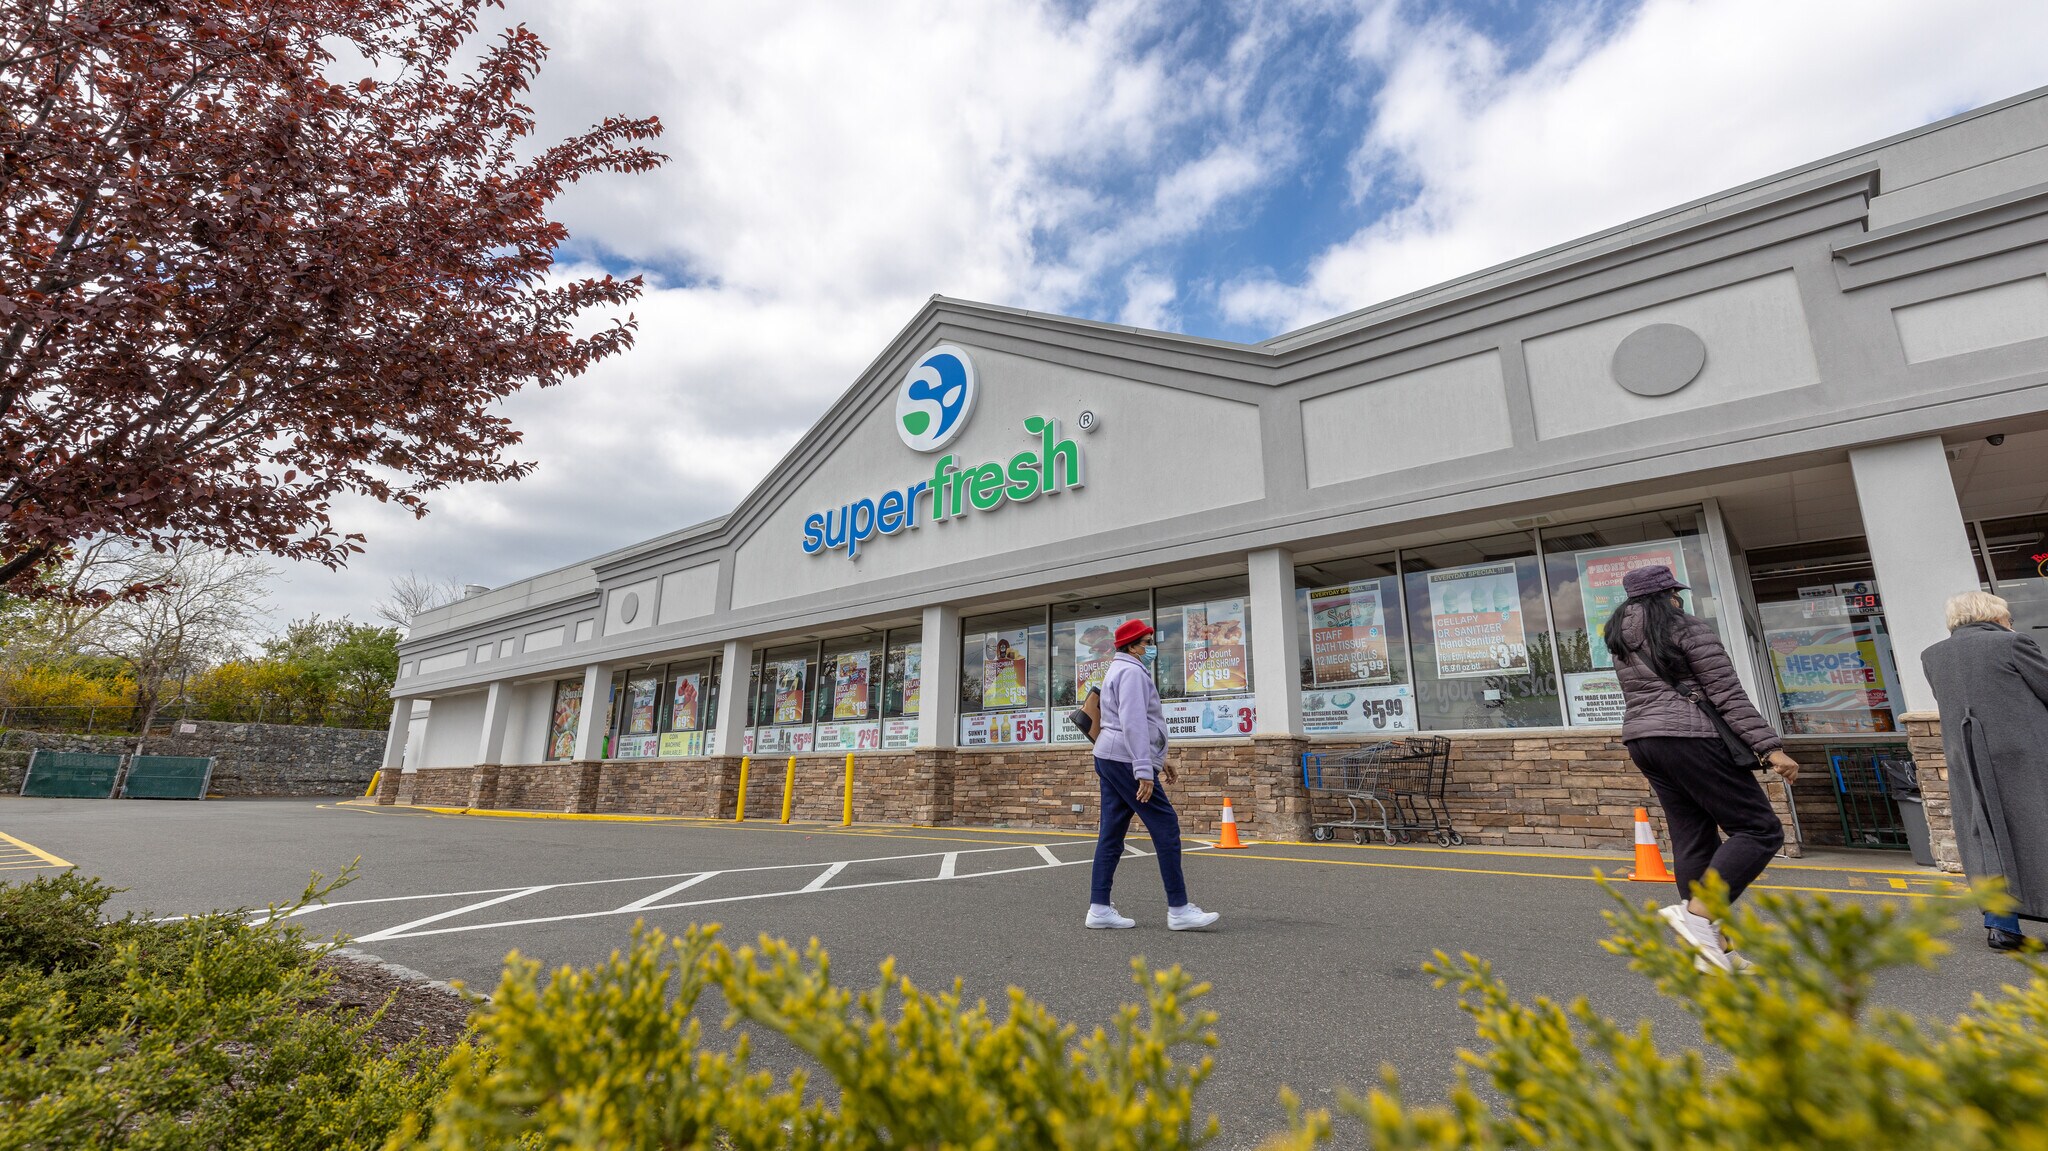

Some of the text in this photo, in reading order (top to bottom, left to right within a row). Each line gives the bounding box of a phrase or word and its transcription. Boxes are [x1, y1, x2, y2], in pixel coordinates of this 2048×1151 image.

[802, 415, 1083, 560] superfresh
[1588, 556, 1673, 574] PHONE ORDERS
[1434, 572, 1467, 581] EVERYDAY
[1468, 569, 1497, 577] SPECIAL
[1311, 589, 1340, 599] EVERYDAY
[1340, 585, 1365, 594] SPECIAL
[1437, 615, 1479, 627] CELLAPY
[1315, 630, 1342, 642] STAFF
[1454, 623, 1502, 637] SANITIZER
[1316, 638, 1367, 653] BATH TISSUE
[1440, 635, 1506, 649] Hand Sanitizer
[1188, 649, 1232, 661] 51-60 Count
[1316, 649, 1378, 665] 12 MEGA ROLLS
[1189, 657, 1241, 670] COOKED SHRIMP
[1785, 651, 1865, 673] HEROES
[1079, 670, 1103, 681] SIRLOIN
[1782, 668, 1876, 687] WORK HERE
[1166, 716, 1200, 724] CARLSTADT
[968, 729, 983, 737] SUNNY
[1180, 725, 1196, 733] CUBE
